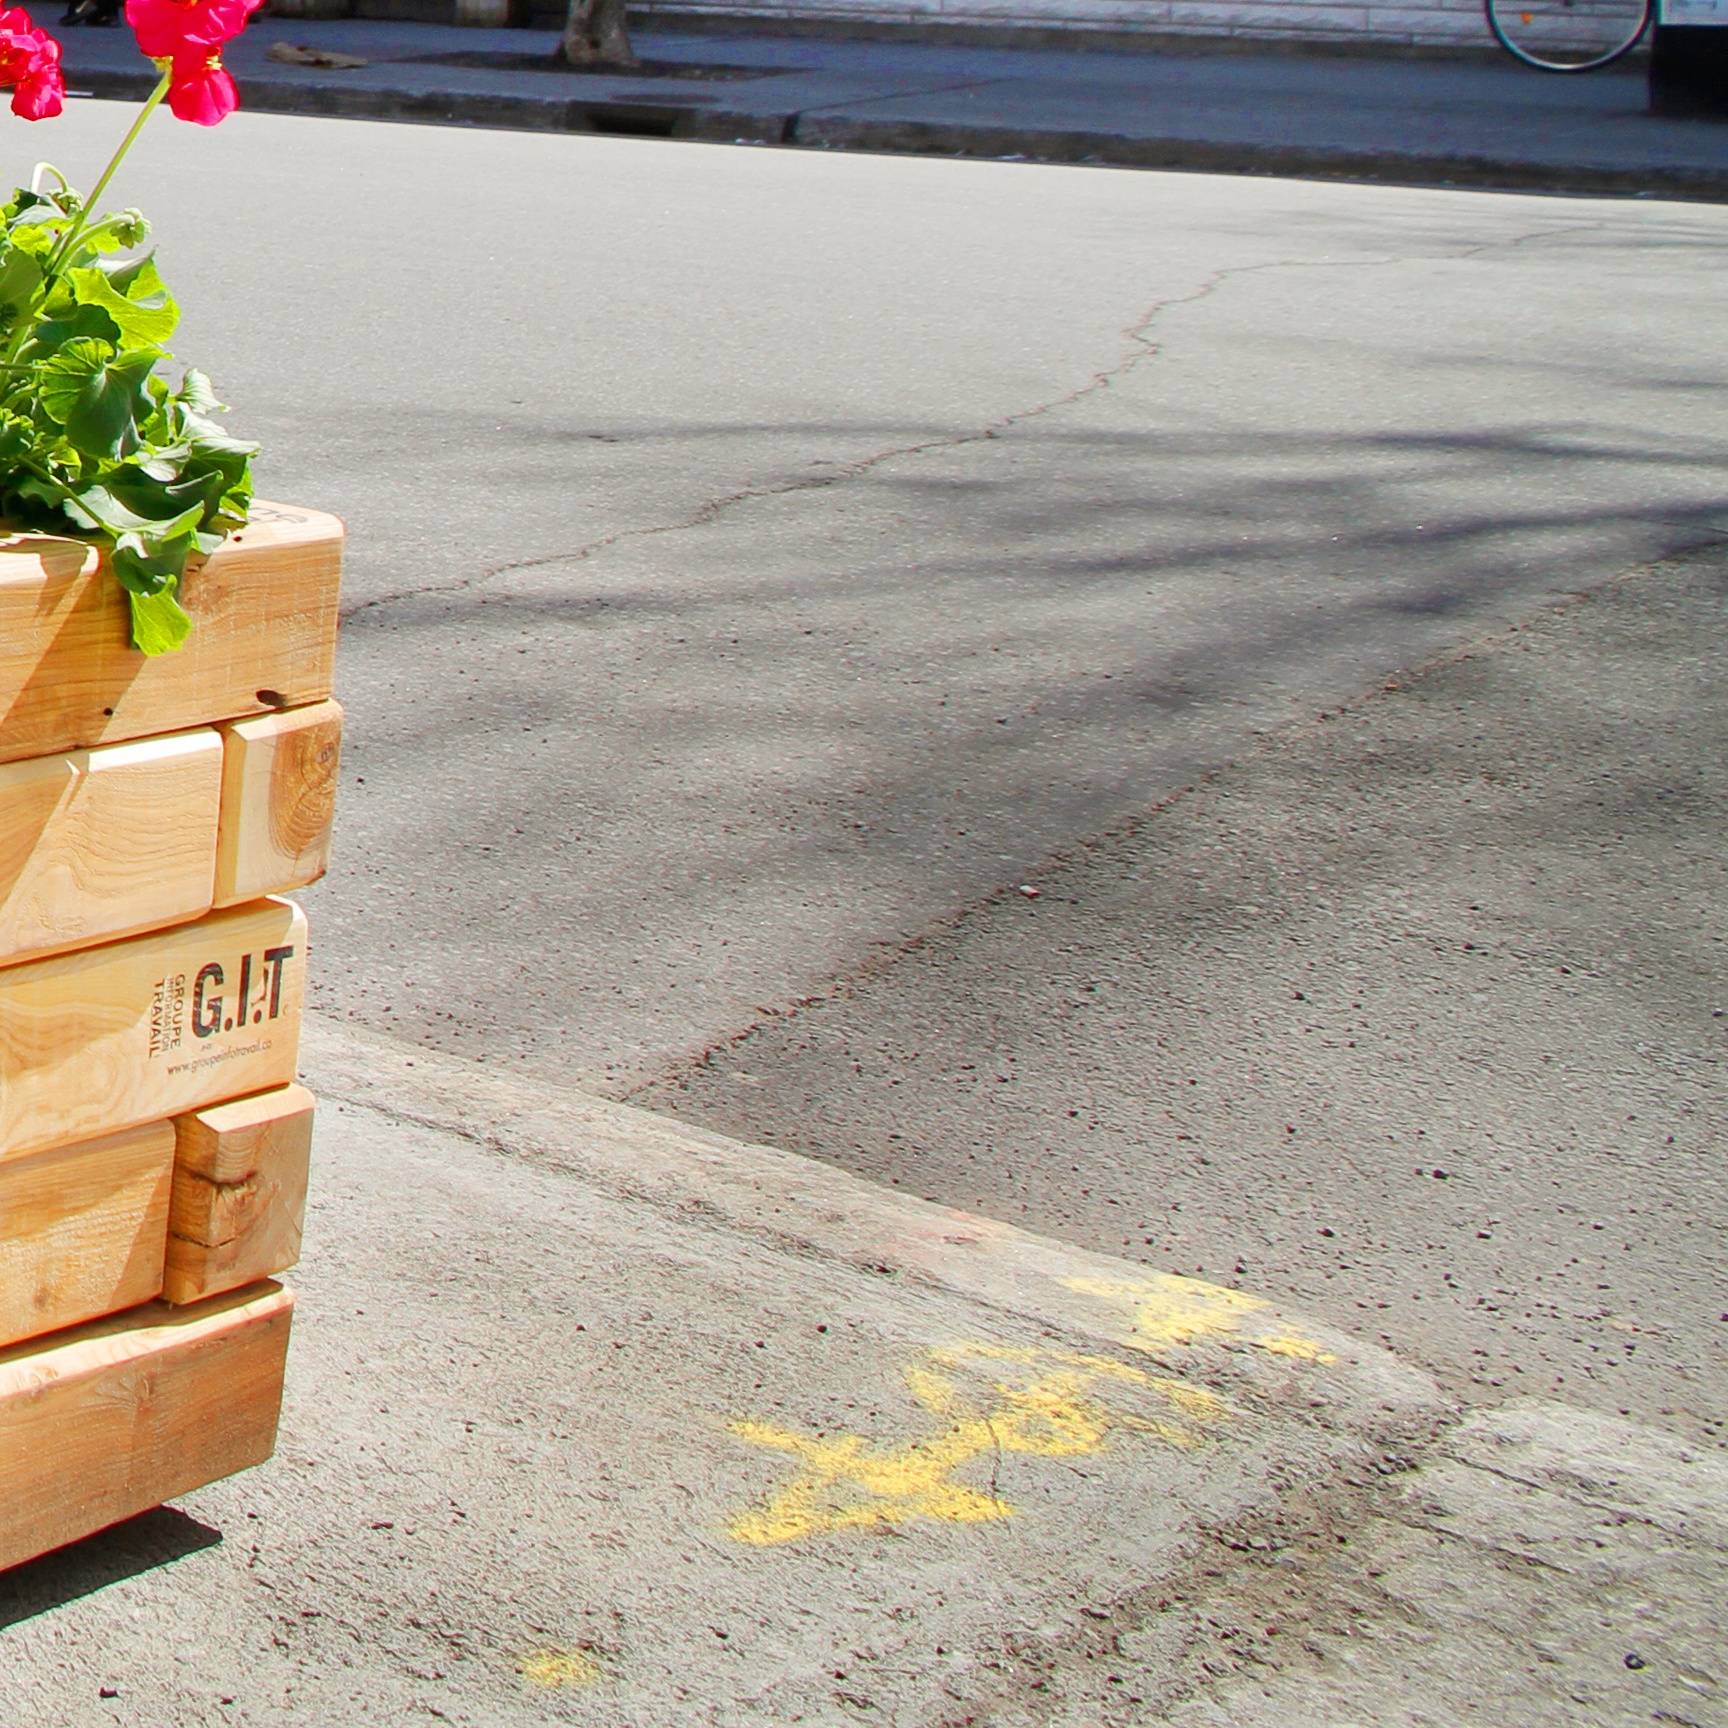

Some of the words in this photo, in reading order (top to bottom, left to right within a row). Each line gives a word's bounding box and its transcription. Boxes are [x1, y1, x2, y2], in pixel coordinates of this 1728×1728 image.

[148, 977, 165, 1060] TRAVAIL
[170, 973, 186, 1050] GROUPE
[191, 944, 295, 1039] G.I.T
